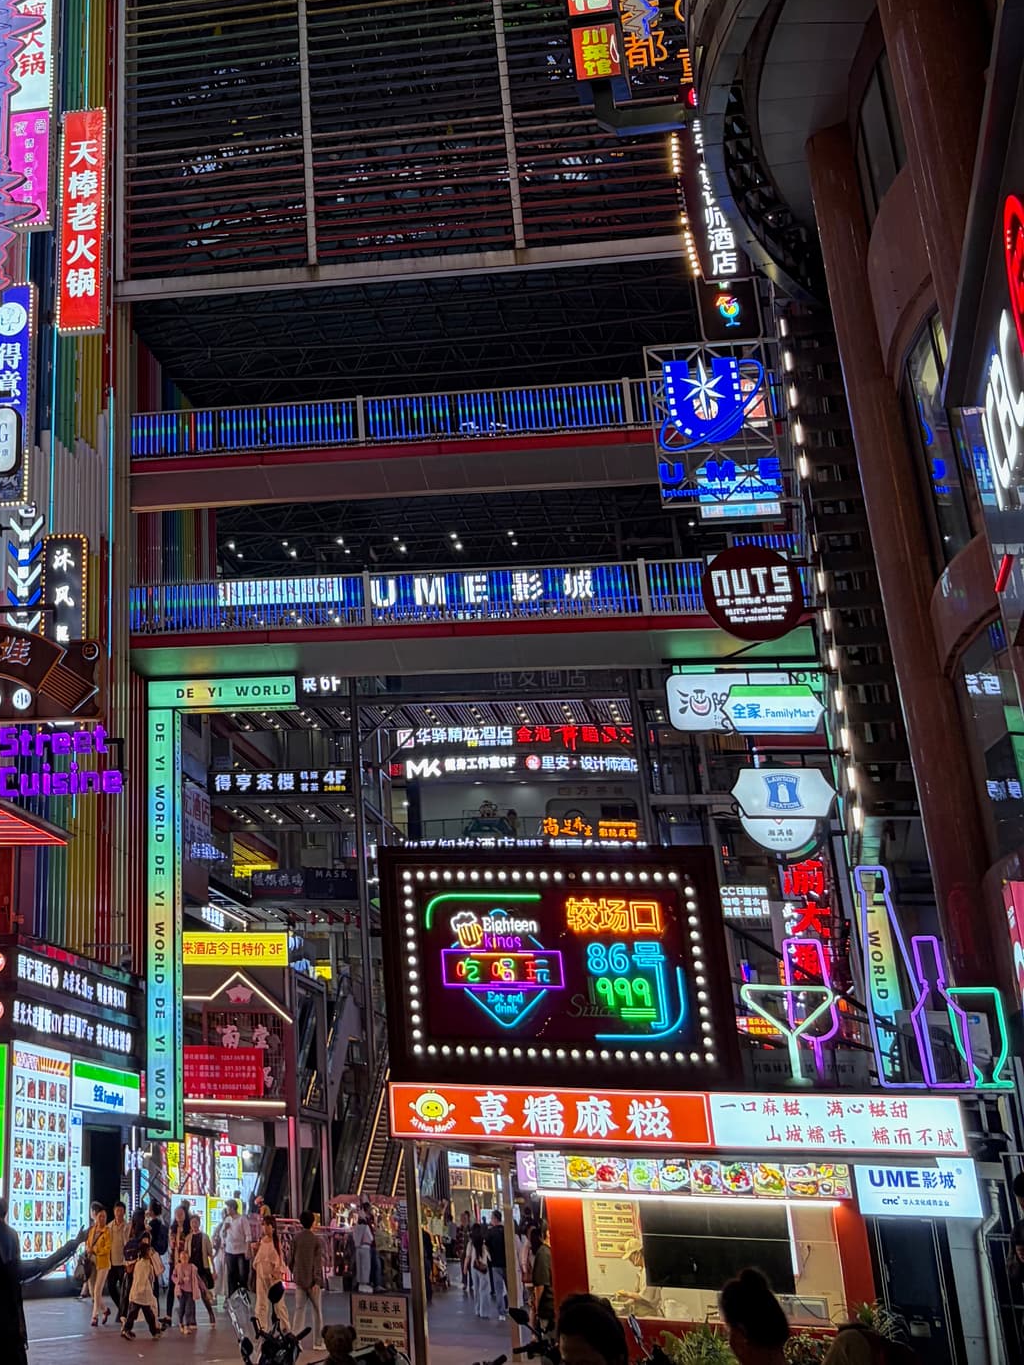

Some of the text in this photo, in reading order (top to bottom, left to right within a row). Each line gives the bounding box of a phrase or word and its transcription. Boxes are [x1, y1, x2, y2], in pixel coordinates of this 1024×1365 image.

[66, 138, 99, 299] 天棒老火锅
[658, 457, 783, 485] UME
[710, 565, 792, 597] NUTS
[176, 684, 291, 699] DE YI WORLD
[732, 702, 761, 720] 全家
[764, 707, 817, 721] FamilyMart
[323, 770, 347, 784] 4F
[154, 783, 166, 844] WORLD
[315, 869, 348, 879] MASK
[480, 915, 539, 934] Eighteen
[565, 897, 663, 934] 较场口
[154, 921, 166, 985] WORLD
[269, 943, 284, 956] 3F
[587, 941, 665, 1030] 86号
[487, 991, 505, 1003] Eat
[494, 1003, 519, 1015] drink
[470, 1090, 674, 1140] 喜糯麻糍
[868, 1168, 957, 1190] UME影城
